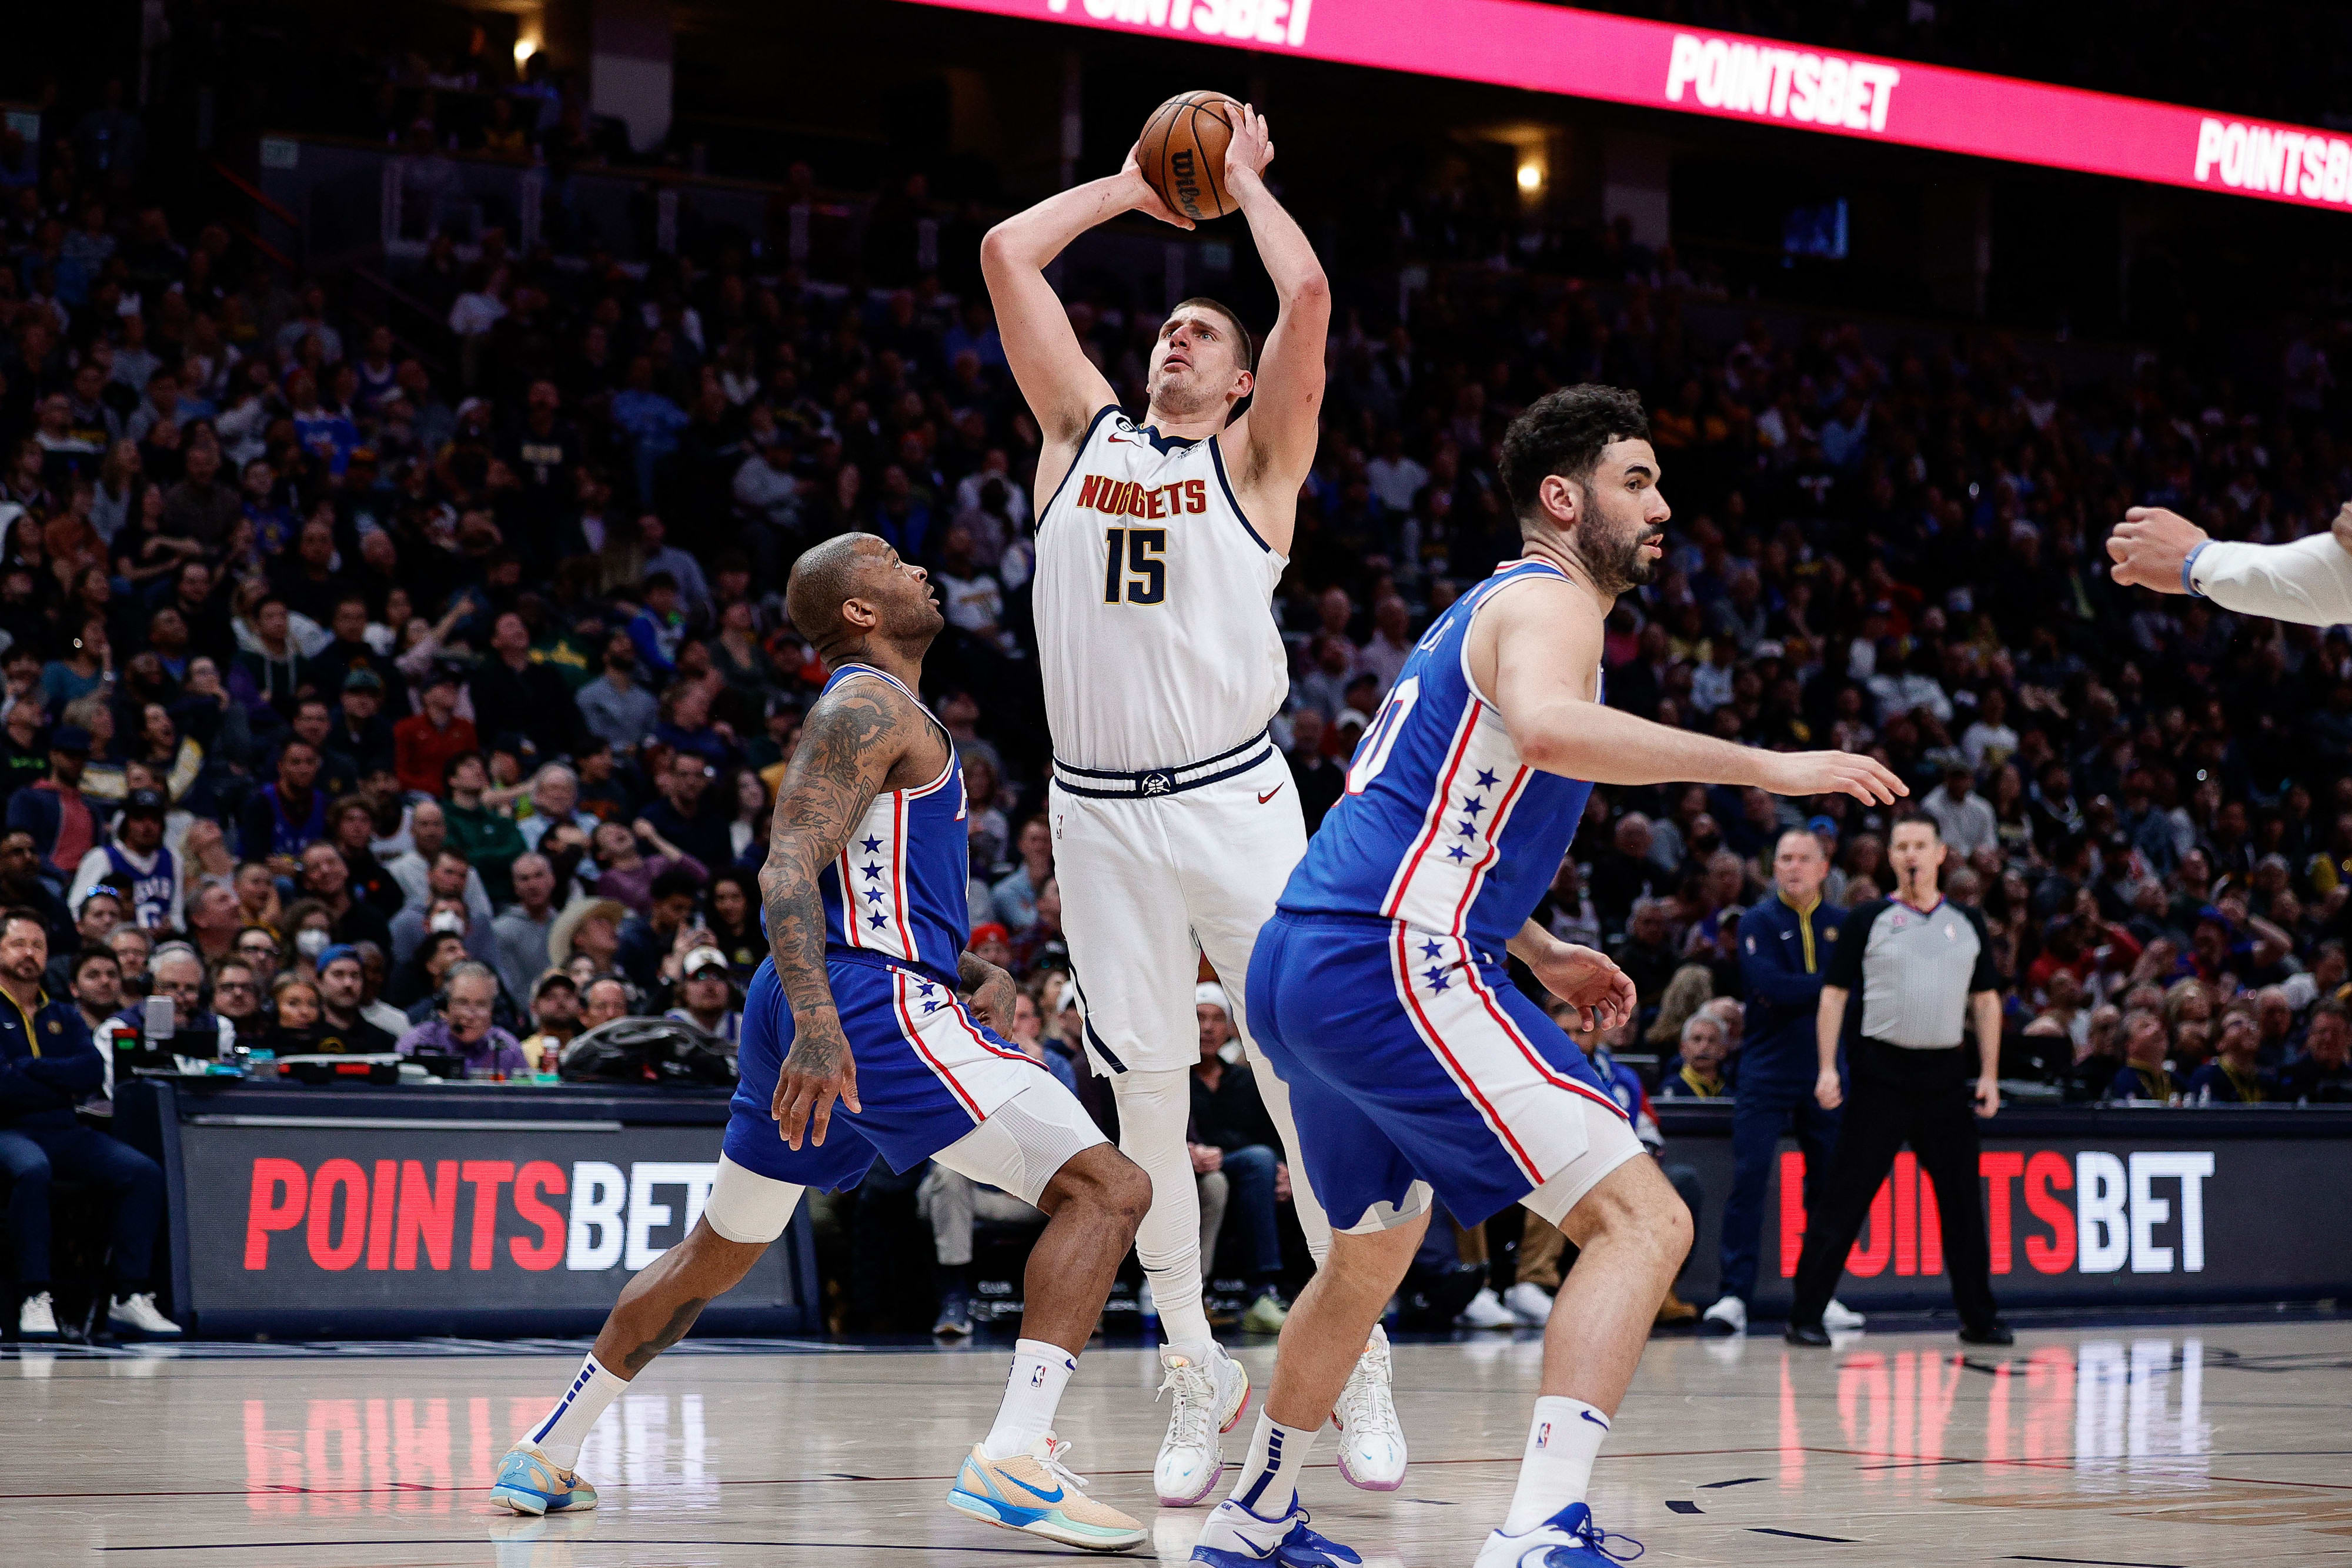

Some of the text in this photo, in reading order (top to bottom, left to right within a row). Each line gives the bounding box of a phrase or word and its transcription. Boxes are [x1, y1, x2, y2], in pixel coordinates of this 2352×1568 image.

[1665, 33, 1900, 132] POINTSBET
[2194, 118, 2352, 206] POINTSB
[1076, 474, 1207, 520] NUGGETS
[1104, 527, 1167, 606] 15
[244, 1158, 719, 1271] POINTSBET
